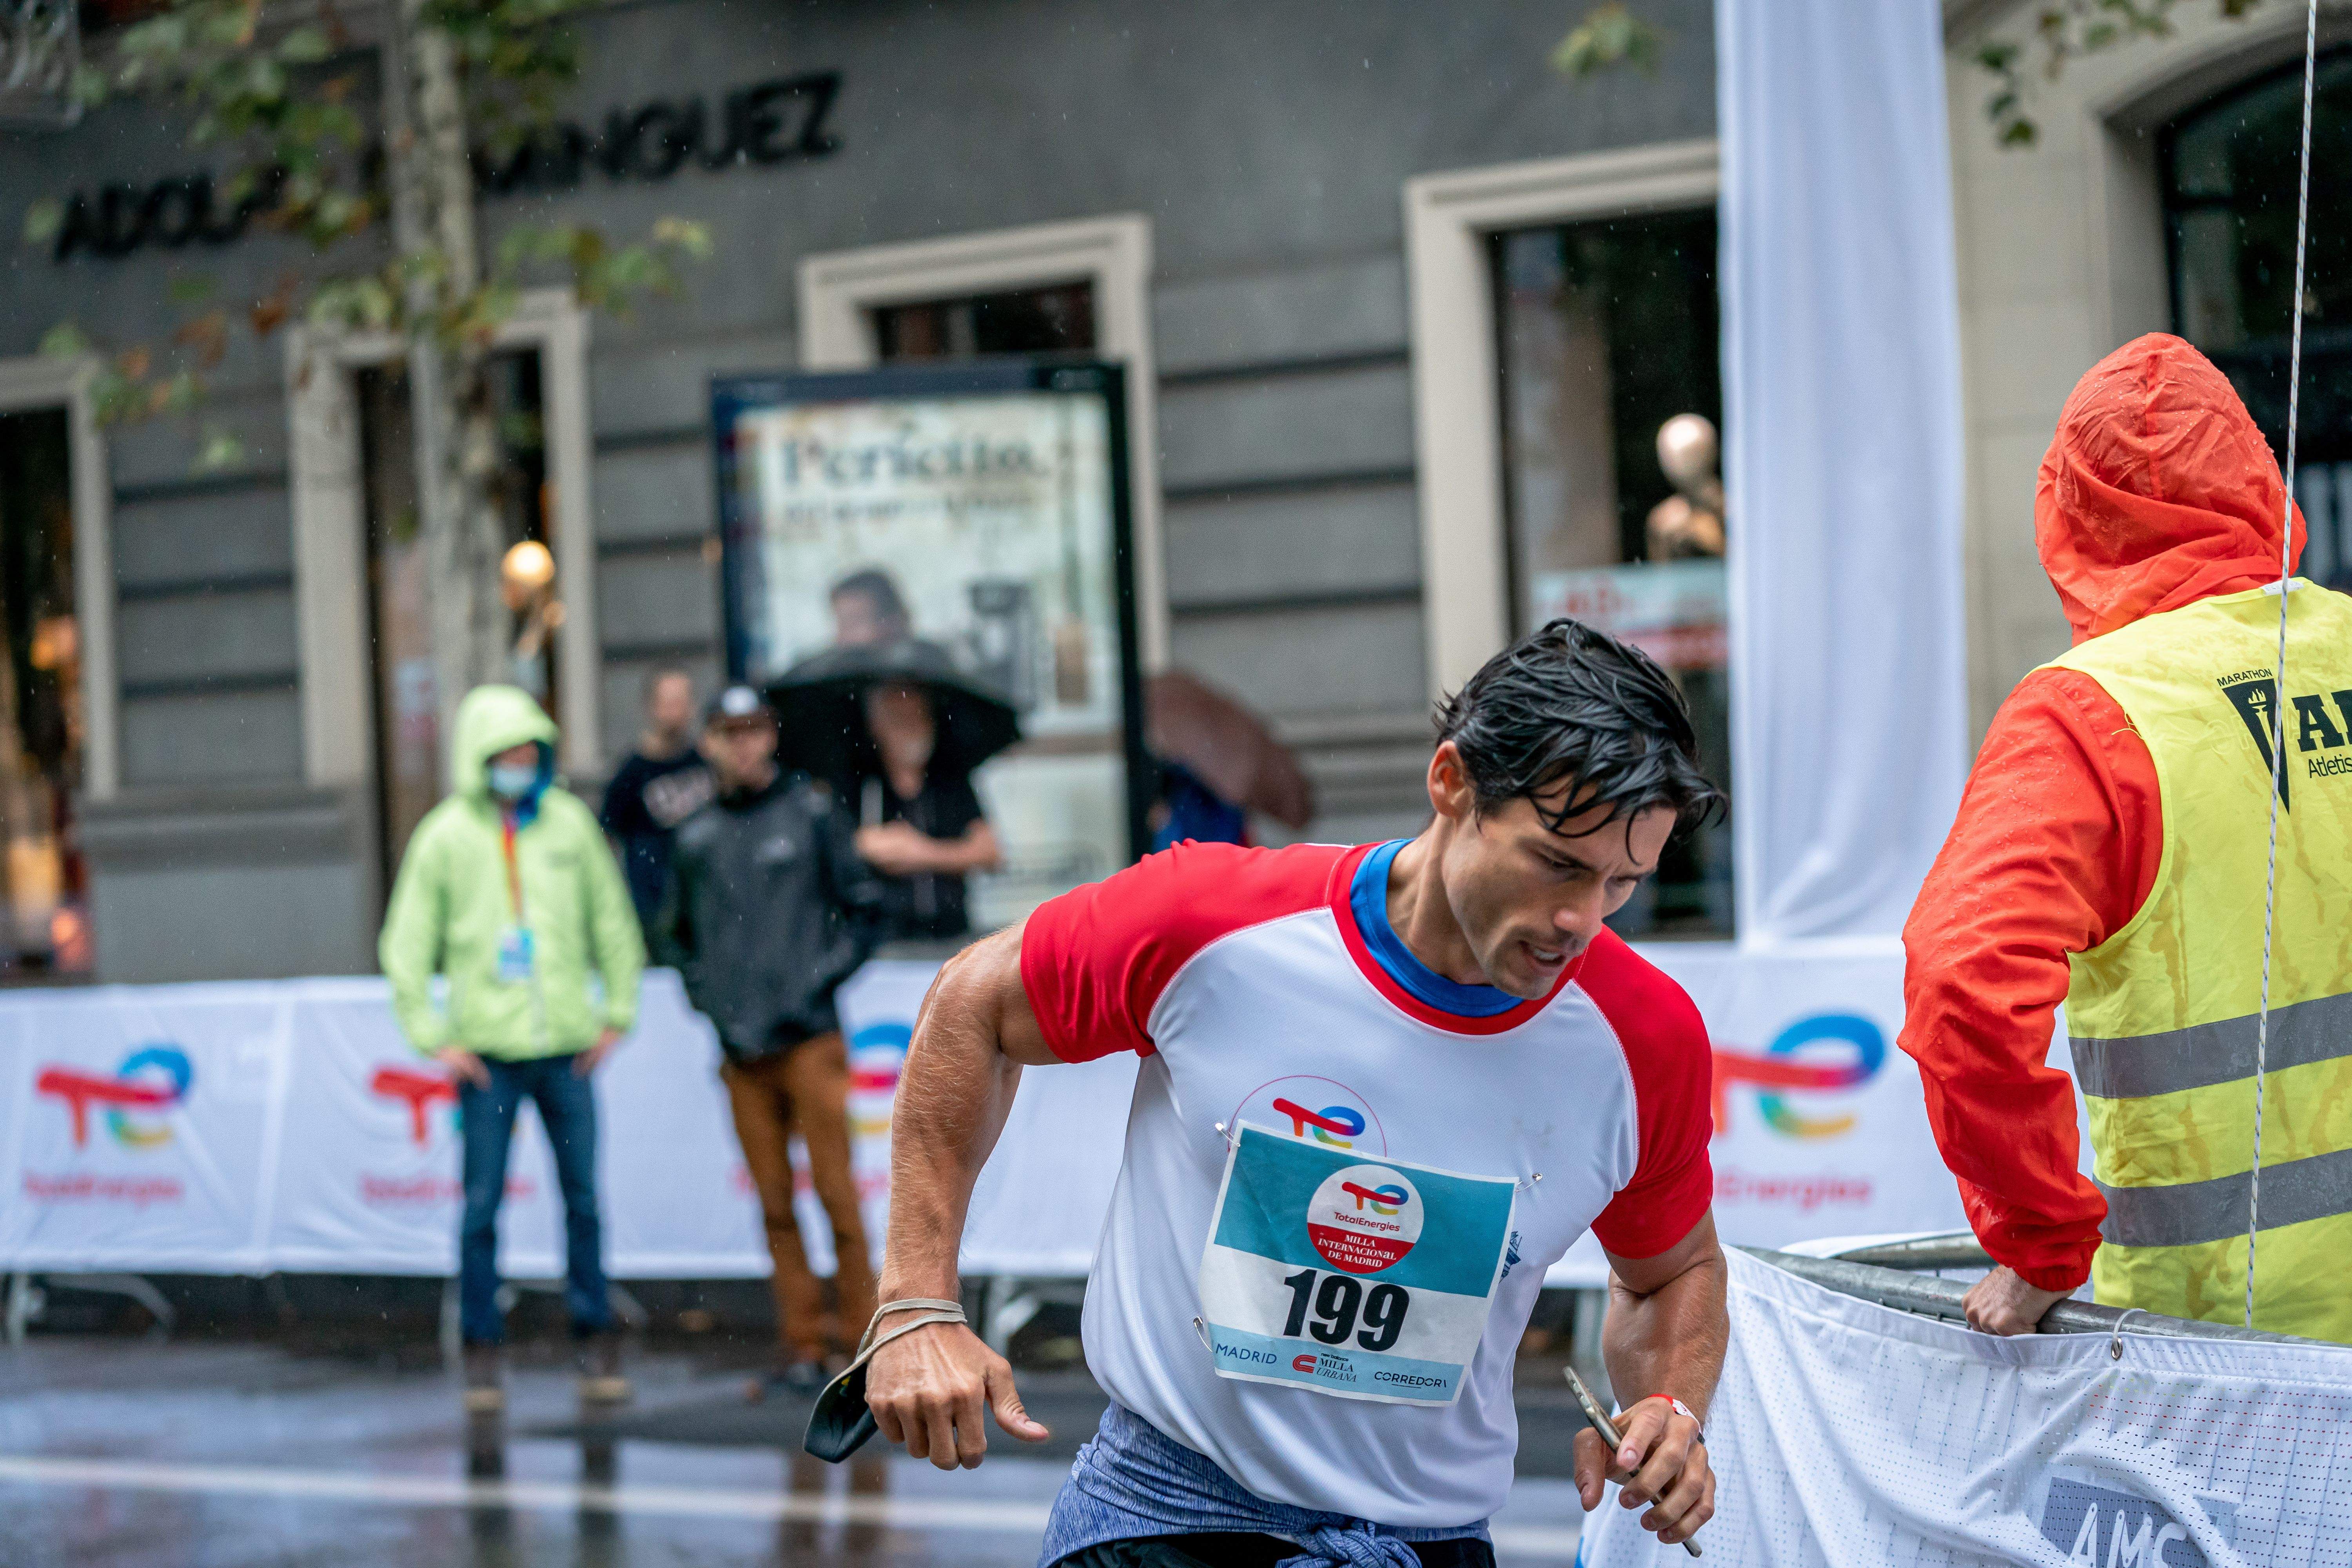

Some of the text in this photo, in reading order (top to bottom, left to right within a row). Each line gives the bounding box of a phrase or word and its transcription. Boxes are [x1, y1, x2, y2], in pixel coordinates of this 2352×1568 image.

[2217, 668, 2273, 686] MARATHON
[2308, 754, 2352, 778] Atletis
[1334, 1212, 1400, 1232] TotalEnergies
[1346, 1234, 1376, 1247] MILLA
[1328, 1250, 1383, 1267] DE MADRID
[1283, 1269, 1410, 1352] 199
[1216, 1343, 1277, 1364] MADRID
[1319, 1358, 1353, 1372] MILLA
[1317, 1367, 1356, 1382] URBANA
